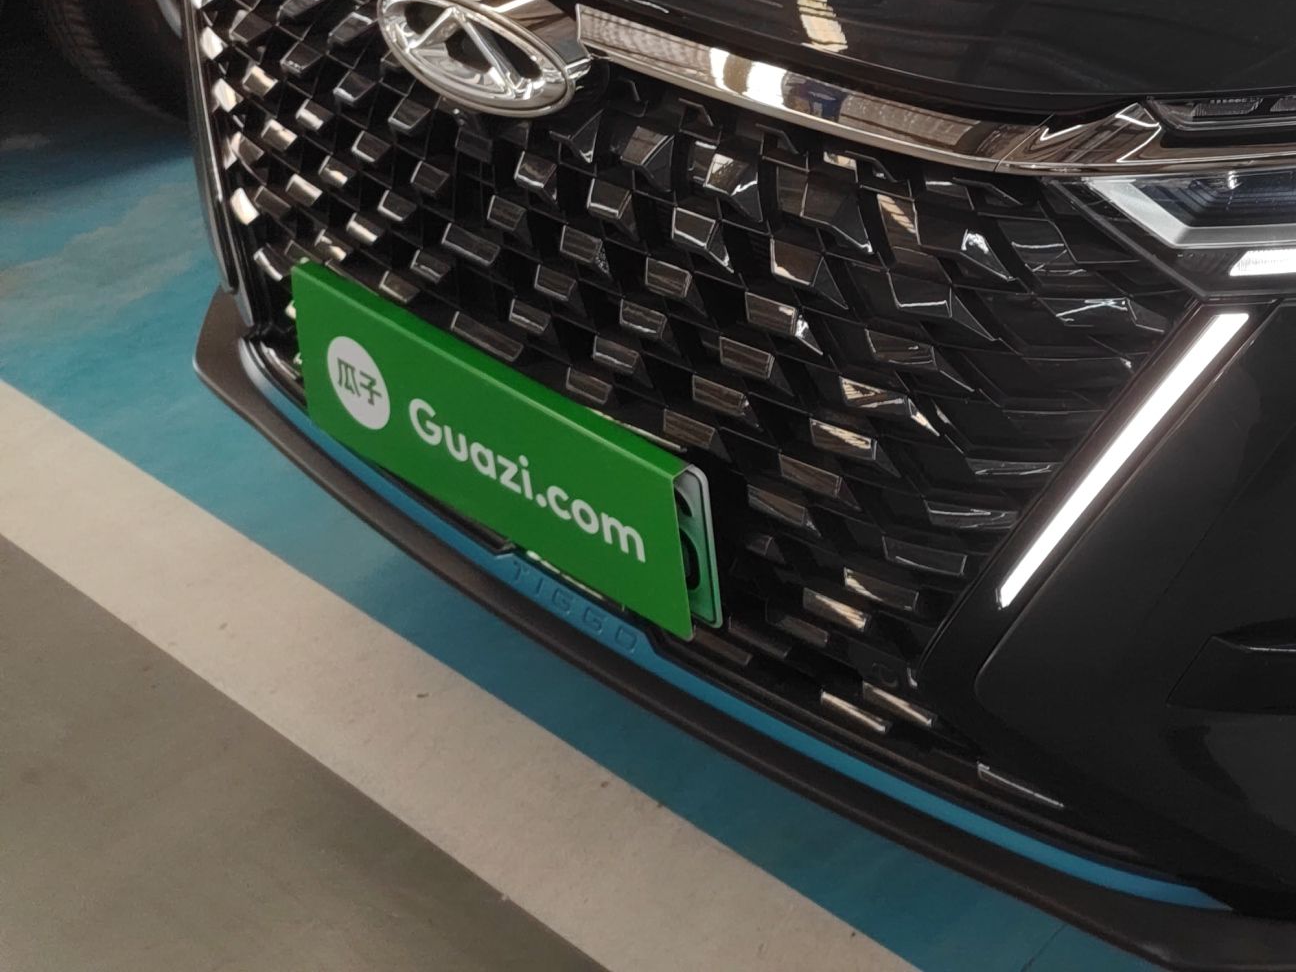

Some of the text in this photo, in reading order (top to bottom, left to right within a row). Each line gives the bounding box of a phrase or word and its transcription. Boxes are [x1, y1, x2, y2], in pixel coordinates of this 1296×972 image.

[337, 357, 382, 406] 瓜子
[408, 398, 646, 563] Guazi.com
[511, 558, 639, 654] TIGGO
